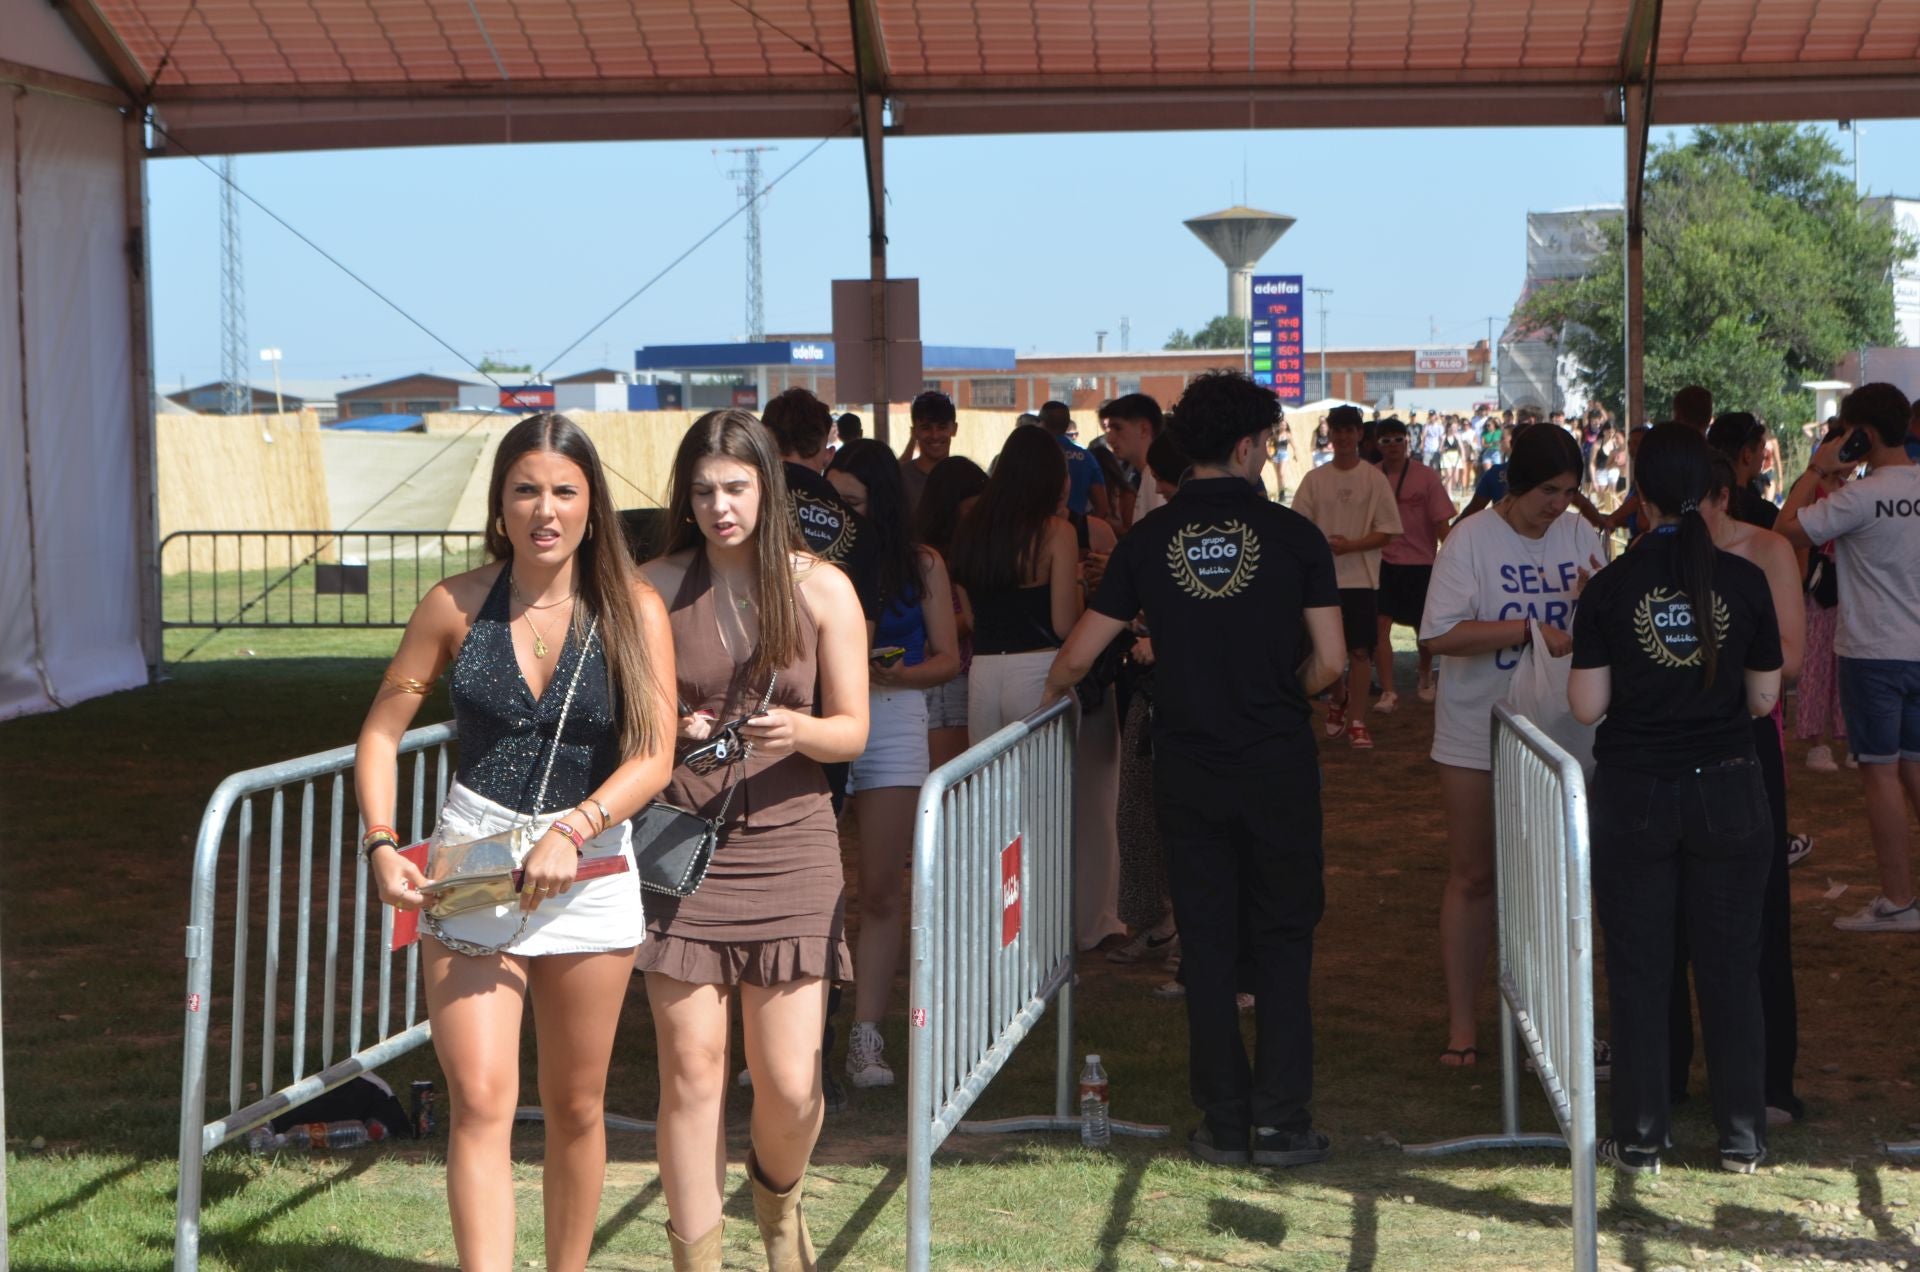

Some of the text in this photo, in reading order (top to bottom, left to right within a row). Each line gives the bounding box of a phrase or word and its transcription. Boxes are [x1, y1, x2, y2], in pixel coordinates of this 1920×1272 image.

[1254, 281, 1299, 295] adelfas
[799, 507, 840, 528] CLOG
[1201, 536, 1226, 546] grupo
[1187, 543, 1238, 561] CLOG
[1500, 561, 1577, 593] SELF
[1654, 611, 1696, 627] CLO
